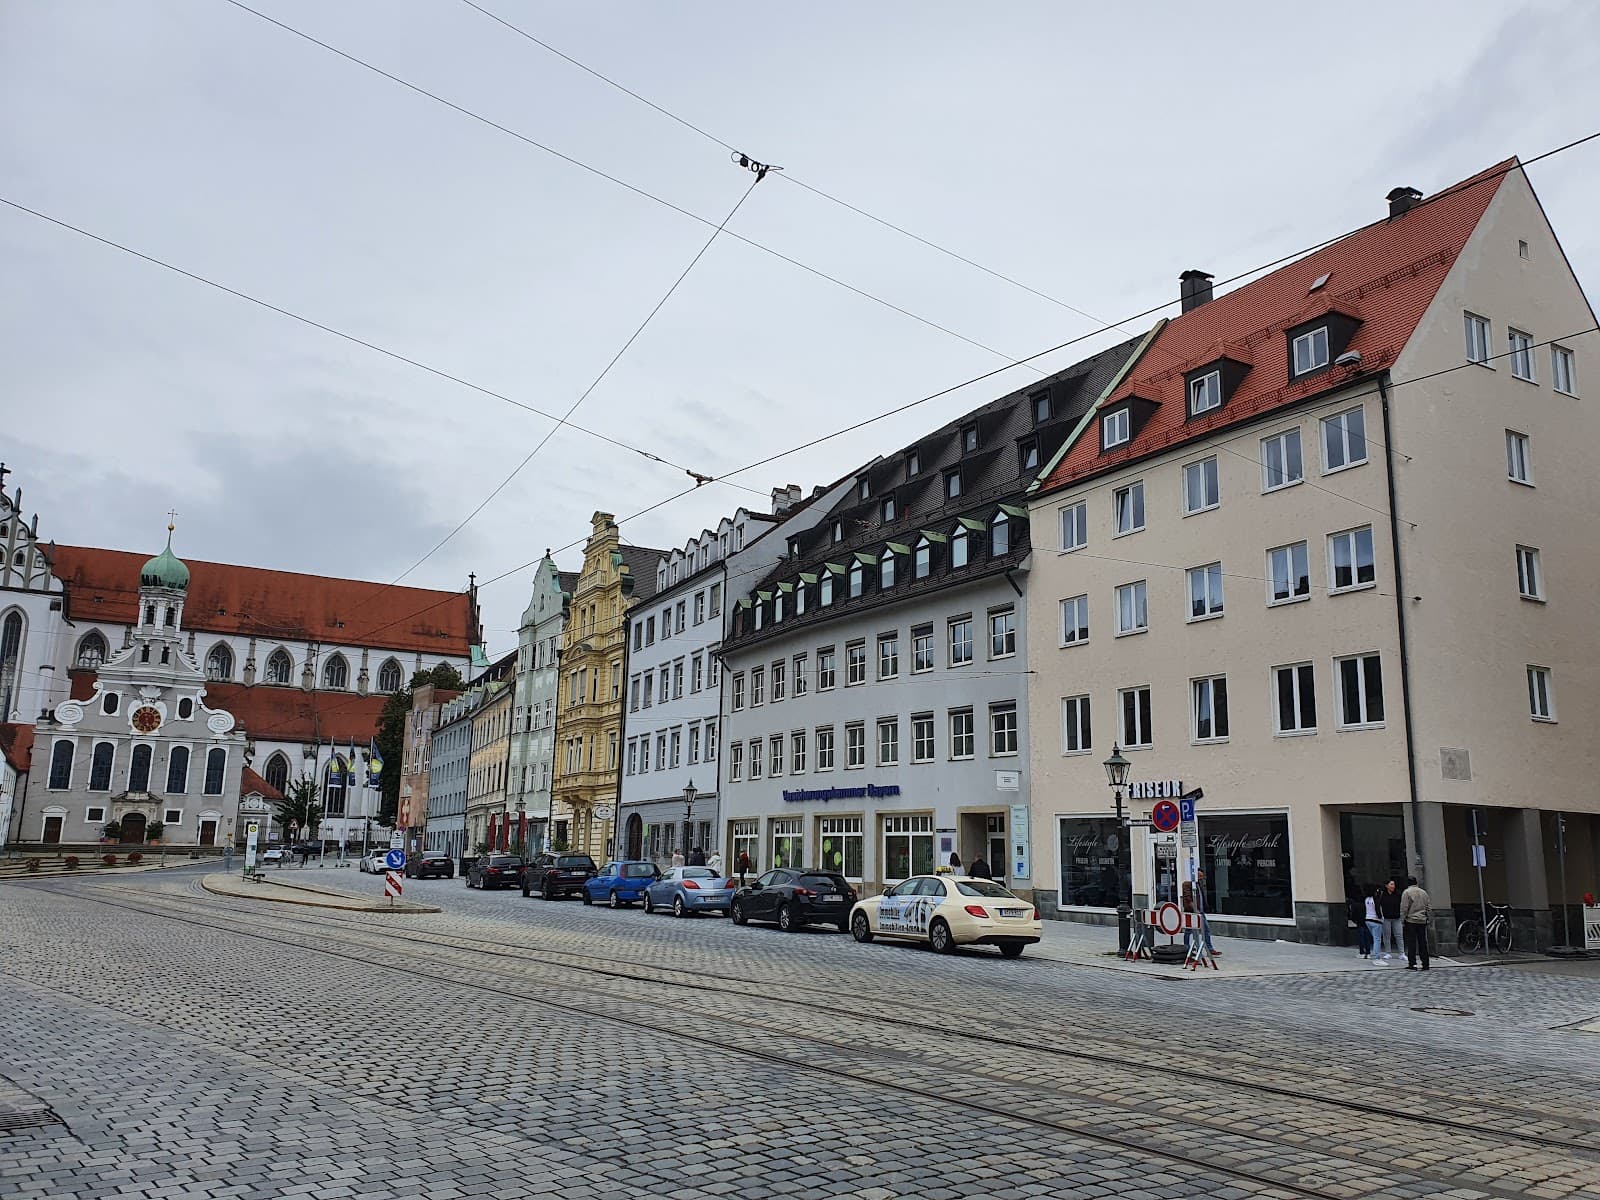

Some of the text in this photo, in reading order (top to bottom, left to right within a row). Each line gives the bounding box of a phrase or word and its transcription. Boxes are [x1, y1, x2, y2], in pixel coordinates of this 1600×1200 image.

[867, 783, 900, 800] Bayern
[1126, 780, 1182, 800] FRISEUR
[1181, 801, 1190, 819] P
[1207, 833, 1248, 856] Lifestyle
[1255, 833, 1282, 848] Ink
